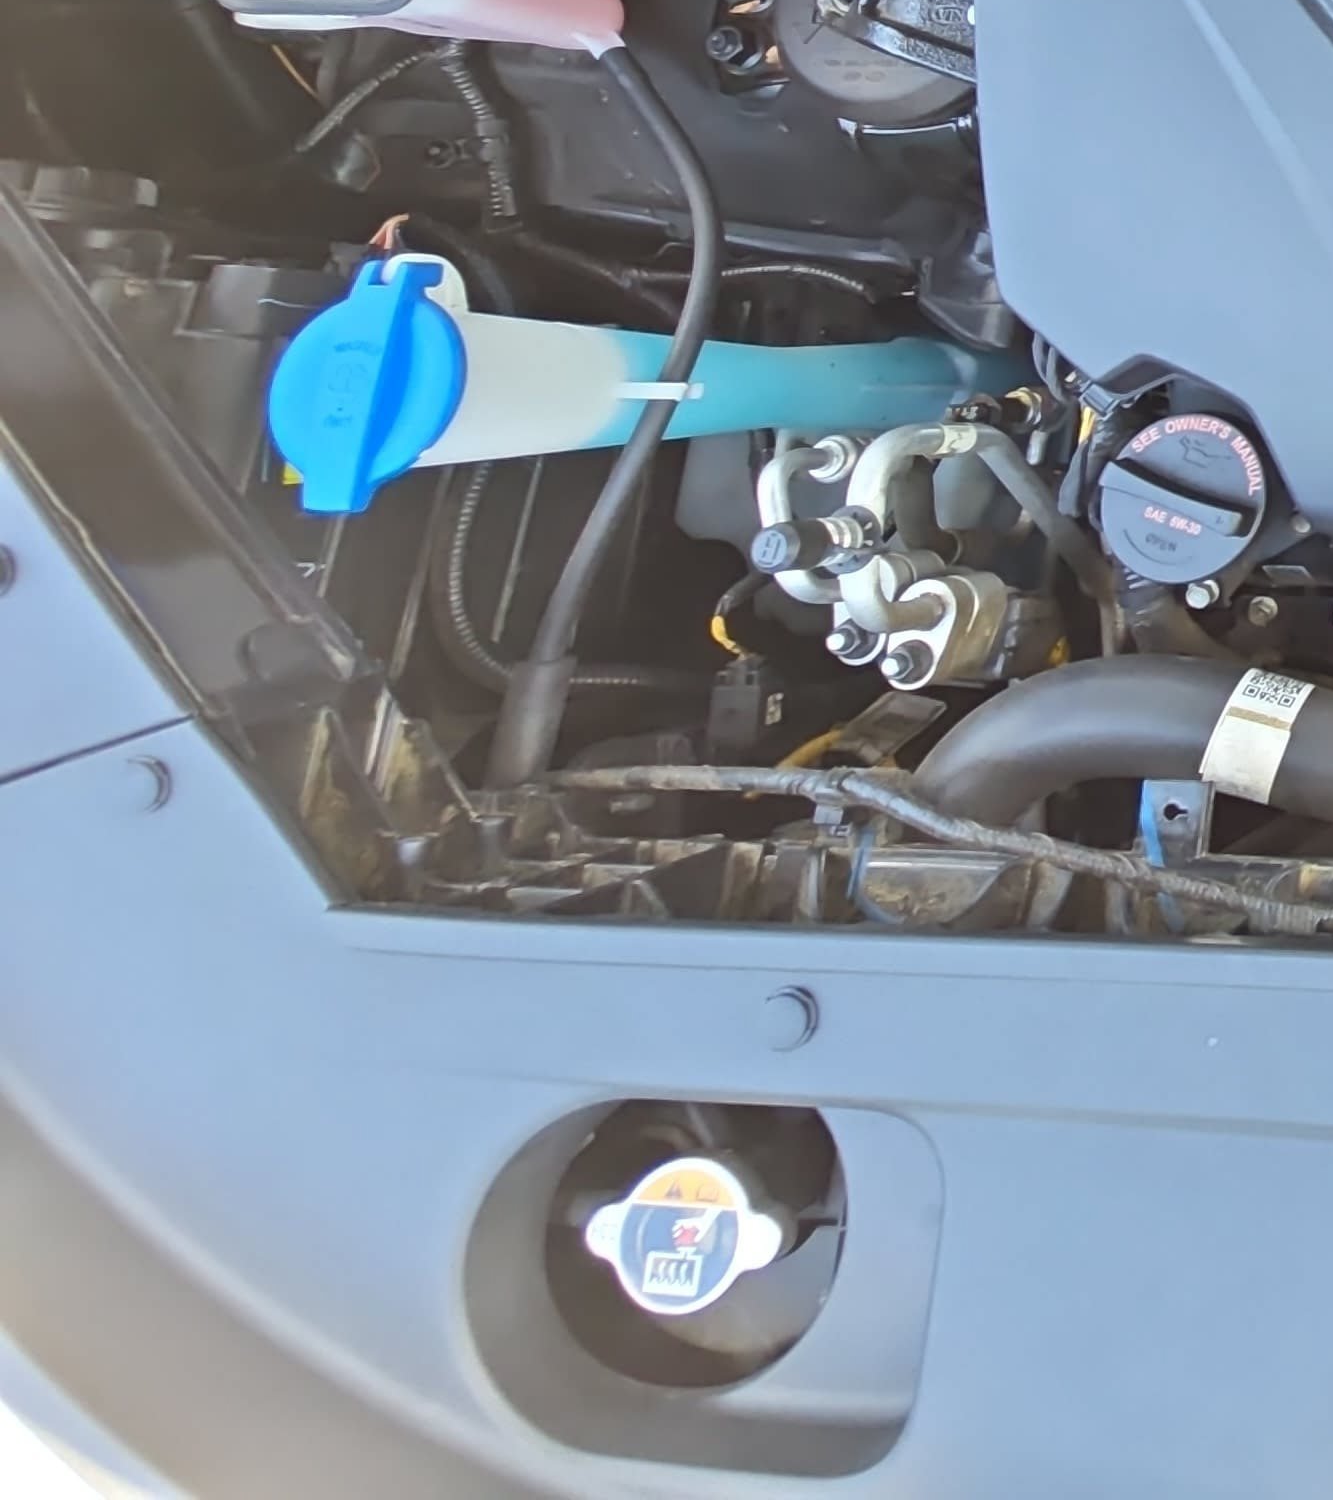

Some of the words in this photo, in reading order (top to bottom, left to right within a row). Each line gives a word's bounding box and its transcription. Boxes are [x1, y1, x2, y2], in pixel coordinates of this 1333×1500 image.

[1131, 427, 1162, 454] SEE
[1164, 417, 1232, 439] OWNER'S
[1230, 436, 1263, 496] MANUAL
[1143, 506, 1167, 525] SAE
[1169, 515, 1203, 536] 5W-30
